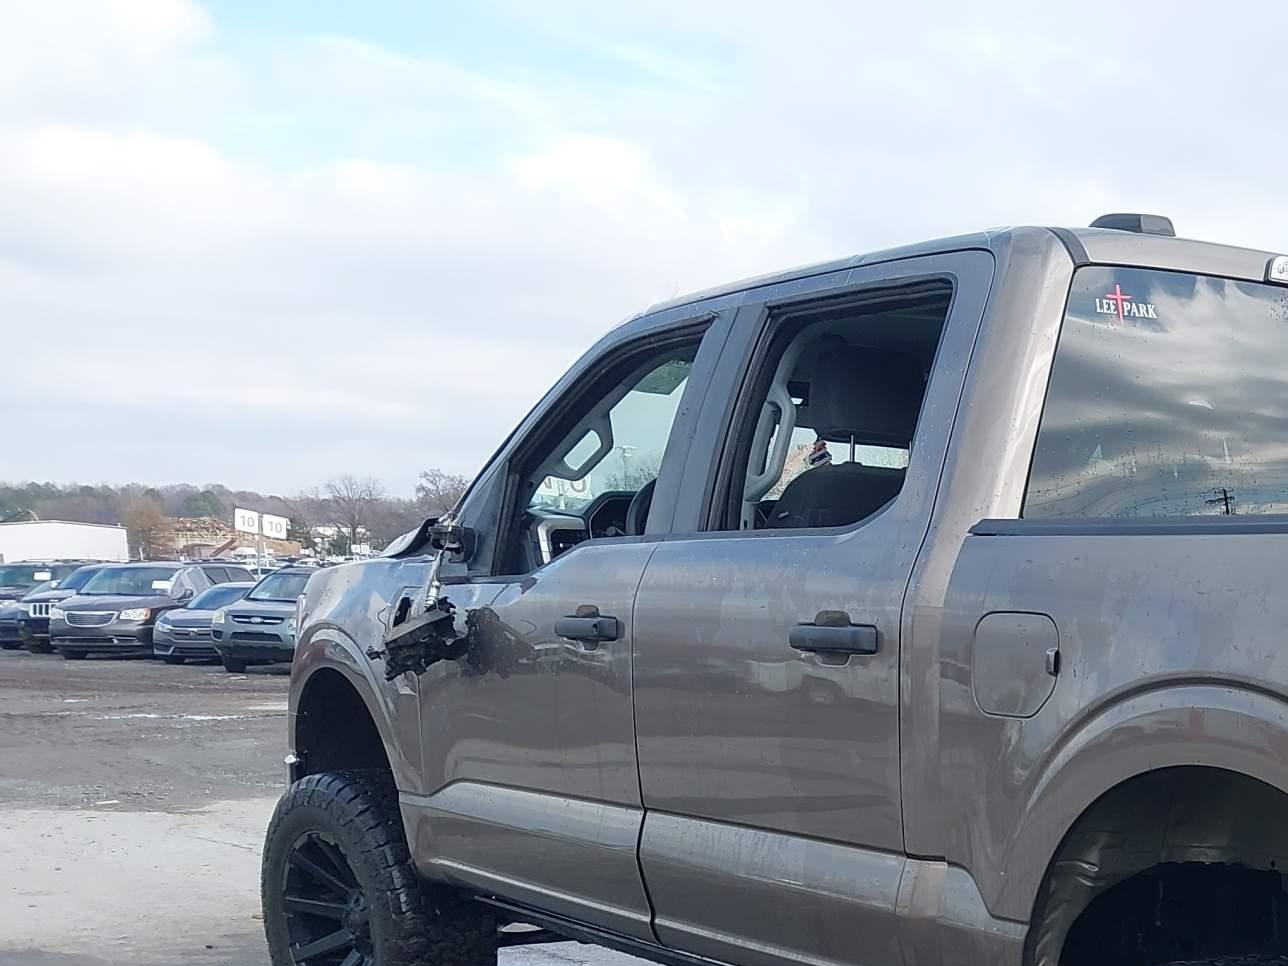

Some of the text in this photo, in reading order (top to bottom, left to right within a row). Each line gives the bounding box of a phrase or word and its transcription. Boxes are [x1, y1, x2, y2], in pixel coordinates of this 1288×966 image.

[1095, 298, 1158, 319] LEE PARK
[240, 515, 255, 528] 10
[268, 521, 283, 534] 10
